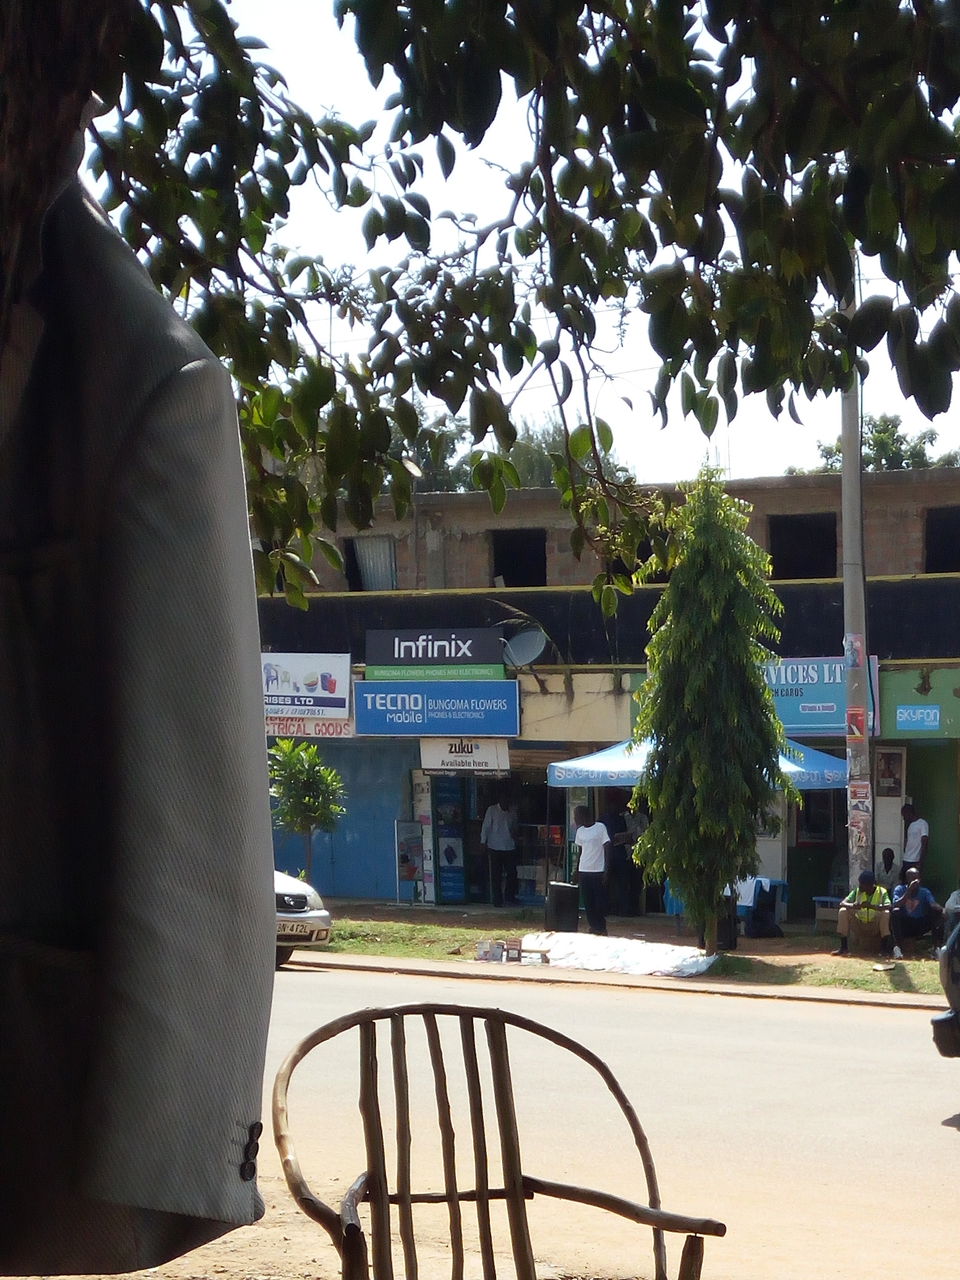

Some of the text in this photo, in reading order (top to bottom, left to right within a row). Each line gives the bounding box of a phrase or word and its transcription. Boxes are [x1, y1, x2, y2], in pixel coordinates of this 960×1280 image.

[394, 634, 472, 658] Infinix
[823, 664, 846, 684] LT
[294, 697, 314, 705] LTD
[363, 693, 422, 710] TECNO
[428, 699, 508, 710] BUNGOMA FLOWERS
[453, 711, 485, 719] ELECTRONICS
[314, 722, 350, 736] GOODS
[448, 738, 474, 754] zuku
